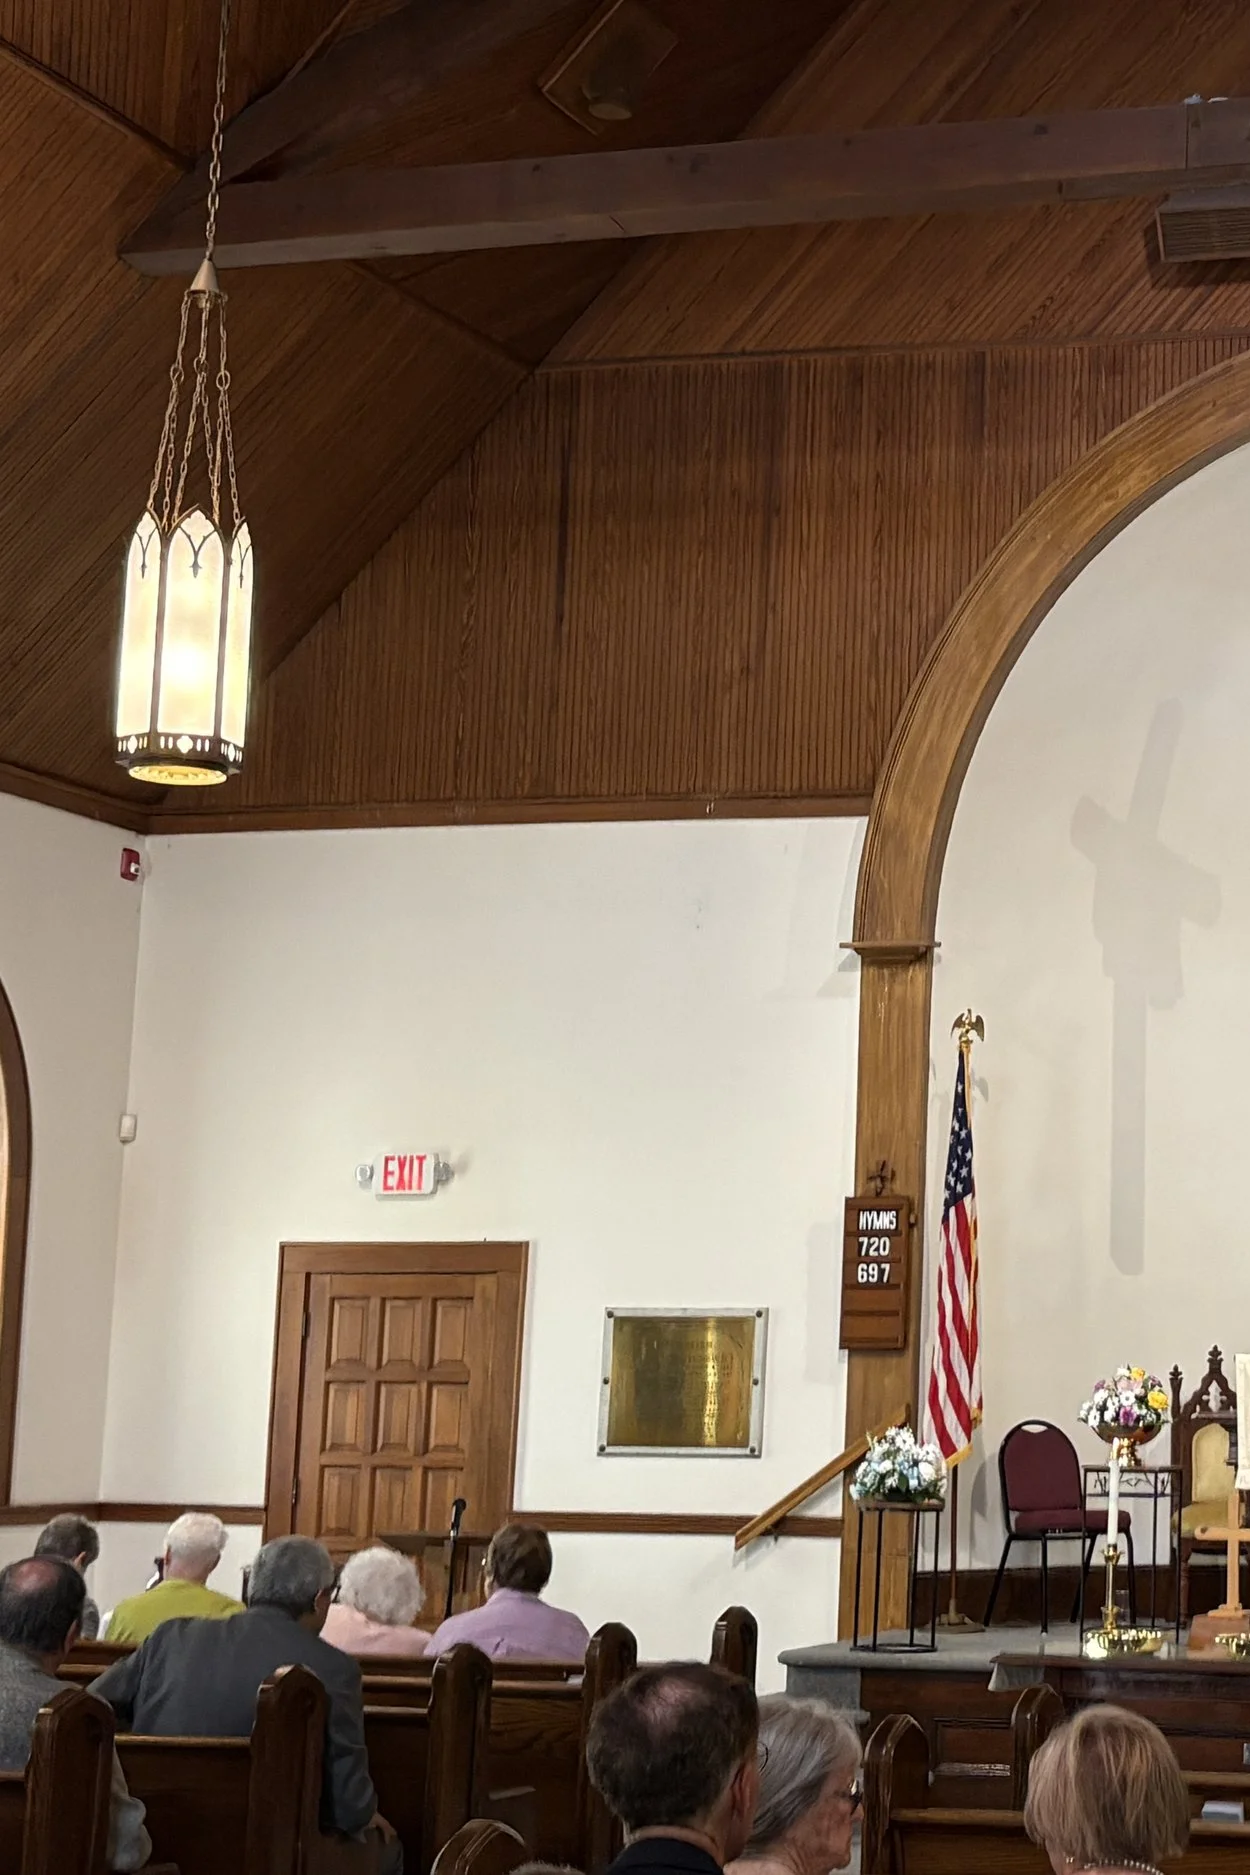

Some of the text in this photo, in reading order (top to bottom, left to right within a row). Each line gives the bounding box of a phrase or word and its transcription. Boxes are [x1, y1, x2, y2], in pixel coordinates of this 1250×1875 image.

[383, 1154, 427, 1191] EXIT
[858, 1210, 897, 1231] HYMNS
[858, 1236, 891, 1257] 720
[857, 1262, 891, 1284] 697
